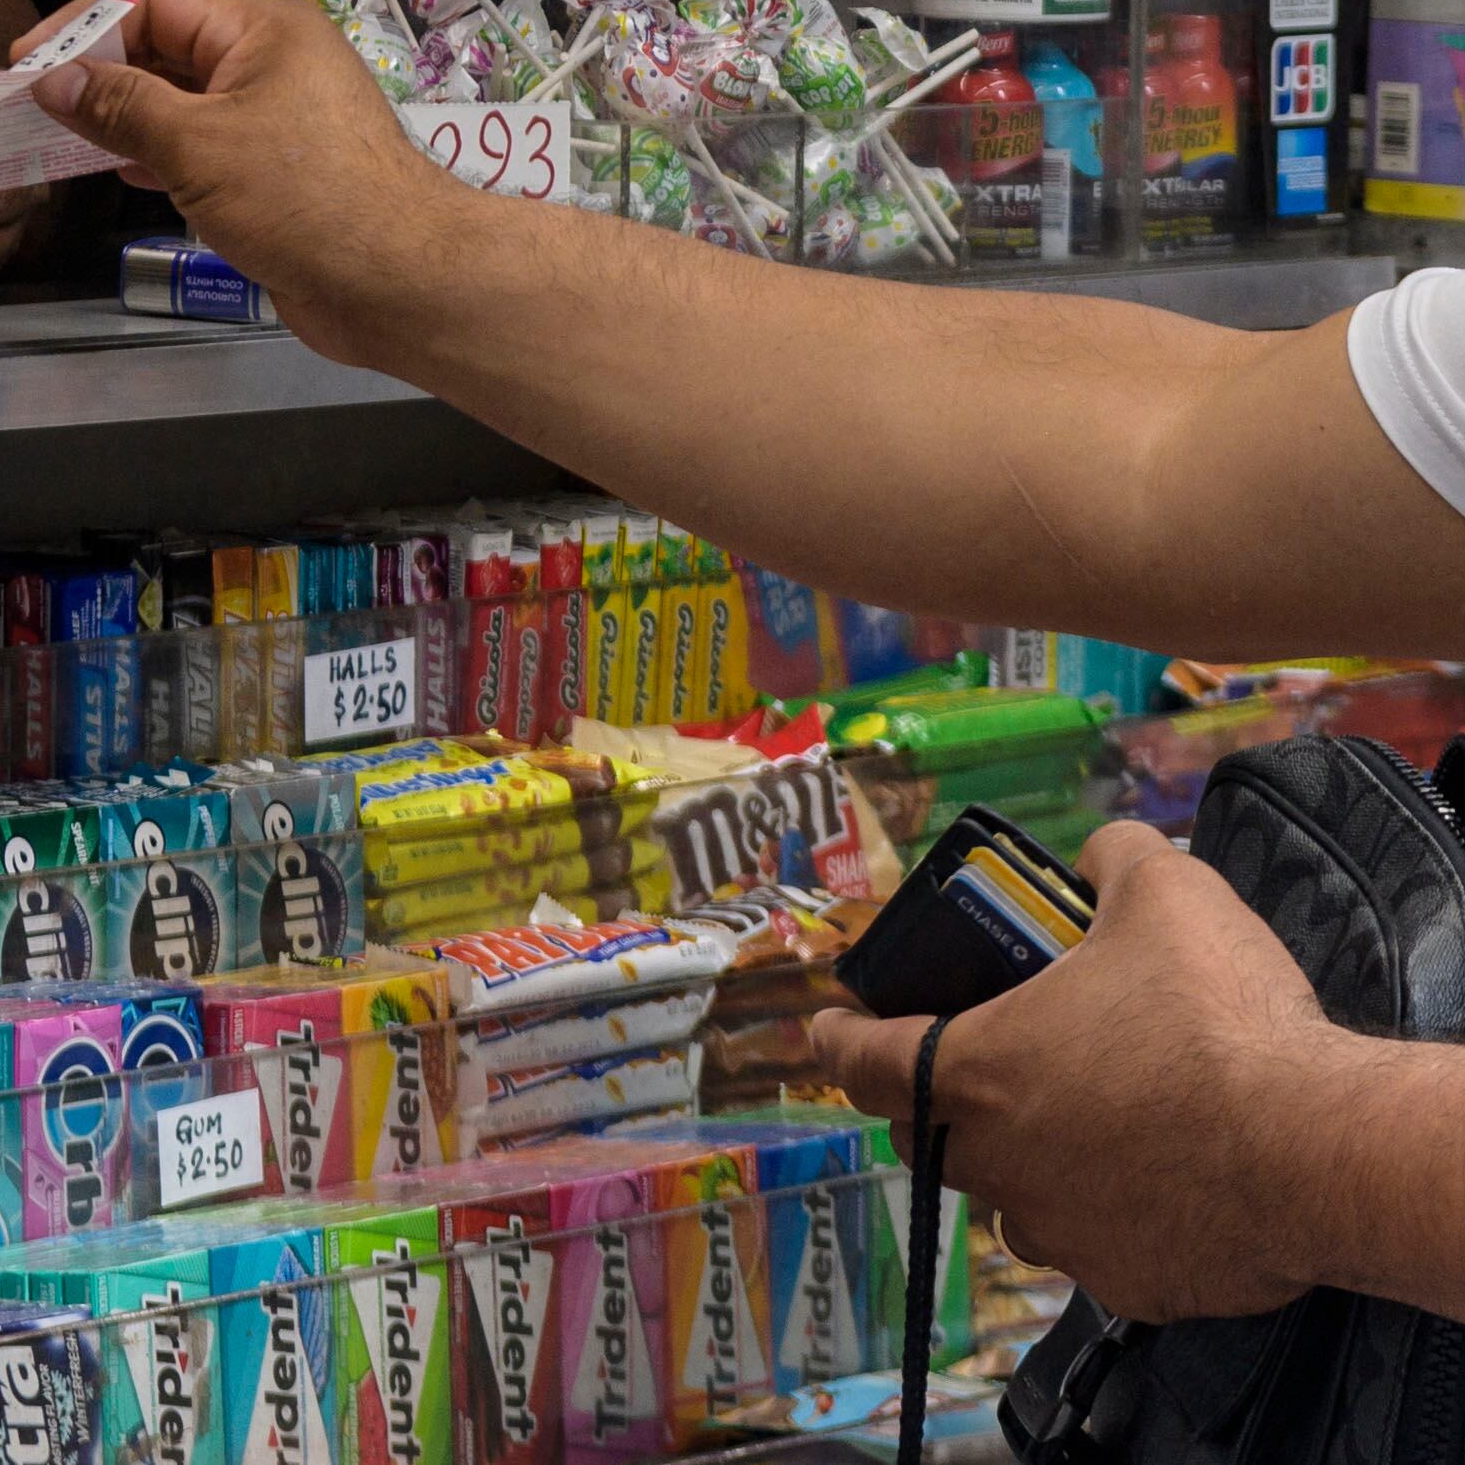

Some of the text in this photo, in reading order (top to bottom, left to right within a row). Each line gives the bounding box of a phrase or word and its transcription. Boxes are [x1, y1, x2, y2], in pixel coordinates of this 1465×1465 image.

[1274, 63, 1329, 93] JCB
[187, 289, 242, 303] CURIOUSLY
[329, 647, 398, 680] HALLS
[475, 605, 506, 725] Ricola
[559, 592, 584, 710] Ricola
[600, 611, 620, 723] Ricola
[637, 607, 658, 723] Ricola
[672, 602, 695, 717] Ricola
[706, 598, 730, 713] Ricola
[957, 895, 1015, 950] CHASE
[174, 1111, 224, 1143] GUM
[486, 1214, 534, 1444] Trident
[593, 1221, 628, 1441] Trident
[702, 1196, 735, 1417] Trident
[799, 1176, 835, 1391] Trident
[39, 1363, 57, 1418] FLAVOR
